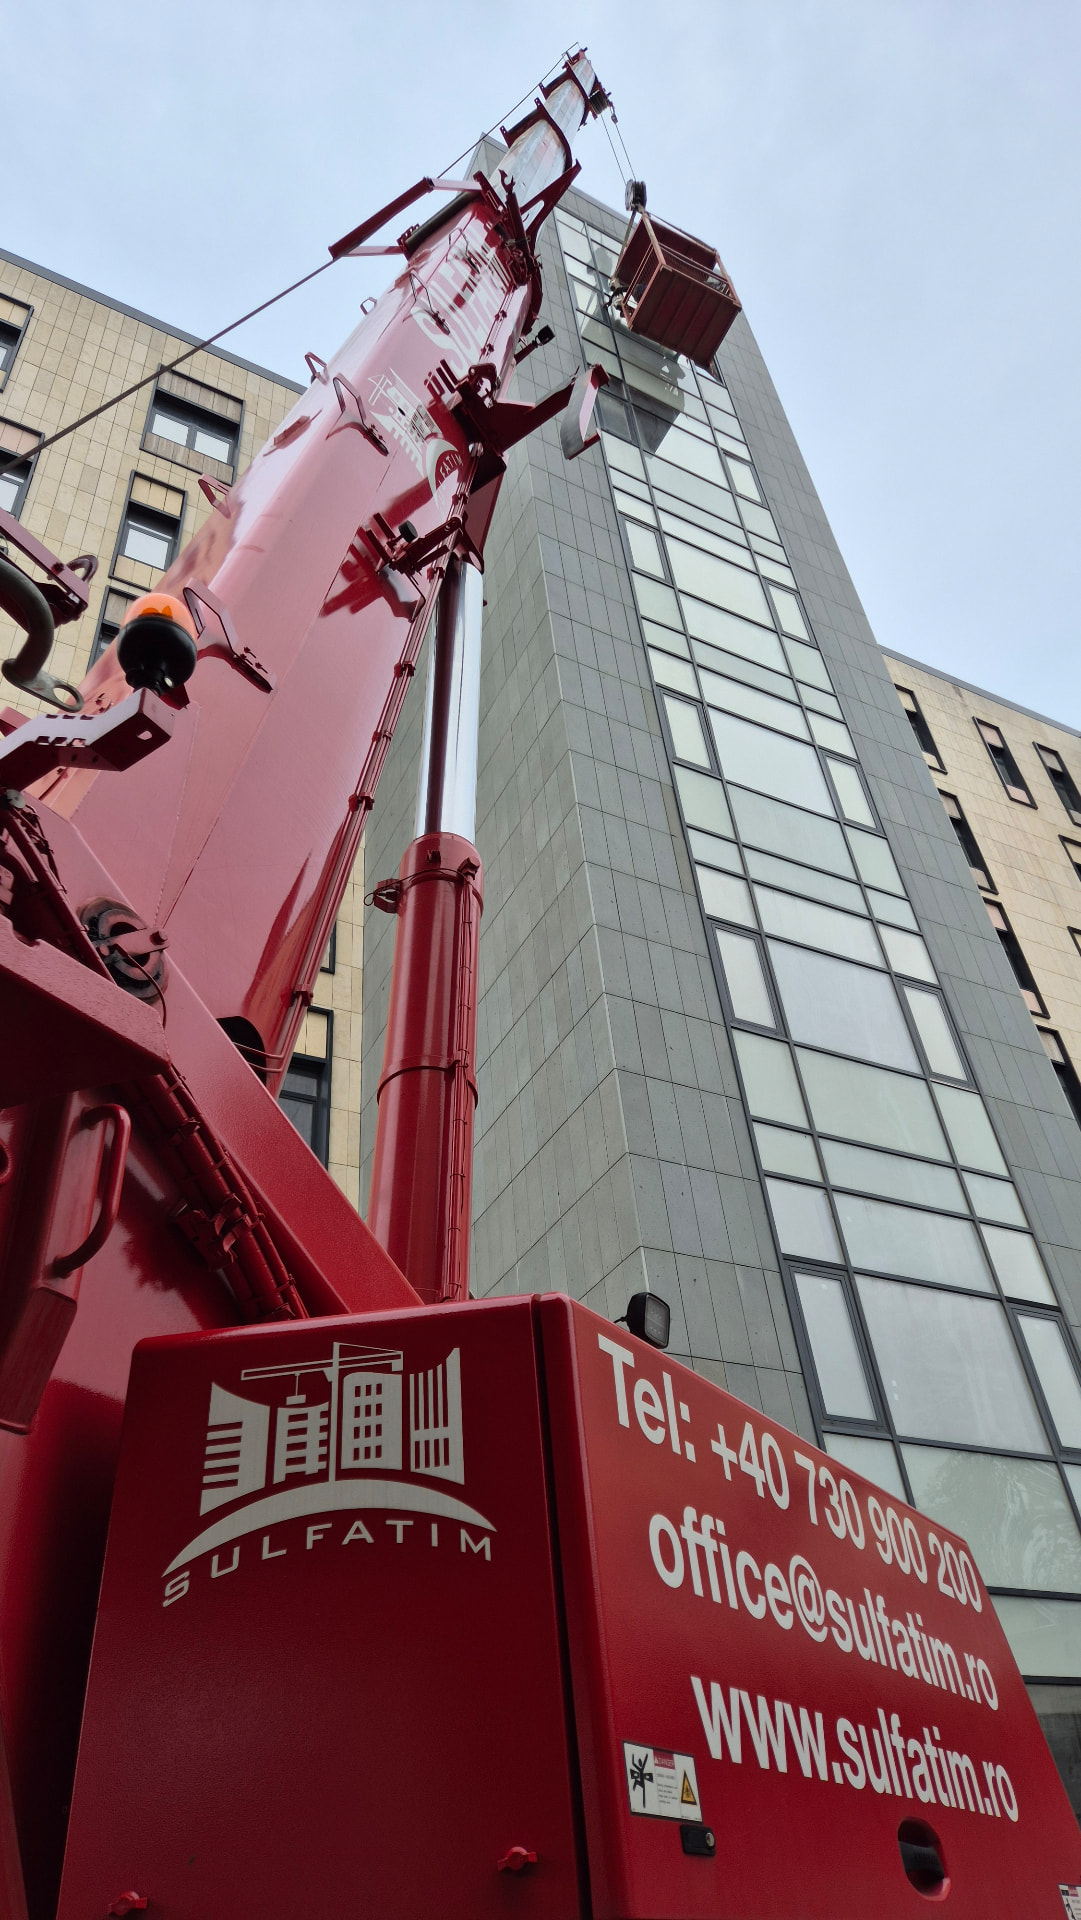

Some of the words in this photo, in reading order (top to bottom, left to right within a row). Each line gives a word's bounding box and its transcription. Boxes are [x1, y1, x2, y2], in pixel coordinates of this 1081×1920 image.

[162, 1519, 492, 1608] SULFATIM
[597, 1333, 697, 1464] Tel:
[710, 1420, 790, 1511] +40
[793, 1449, 866, 1551] 730
[867, 1496, 928, 1585] 900
[928, 1531, 983, 1614] 200
[648, 1506, 999, 1711] office@sulfatim.ro
